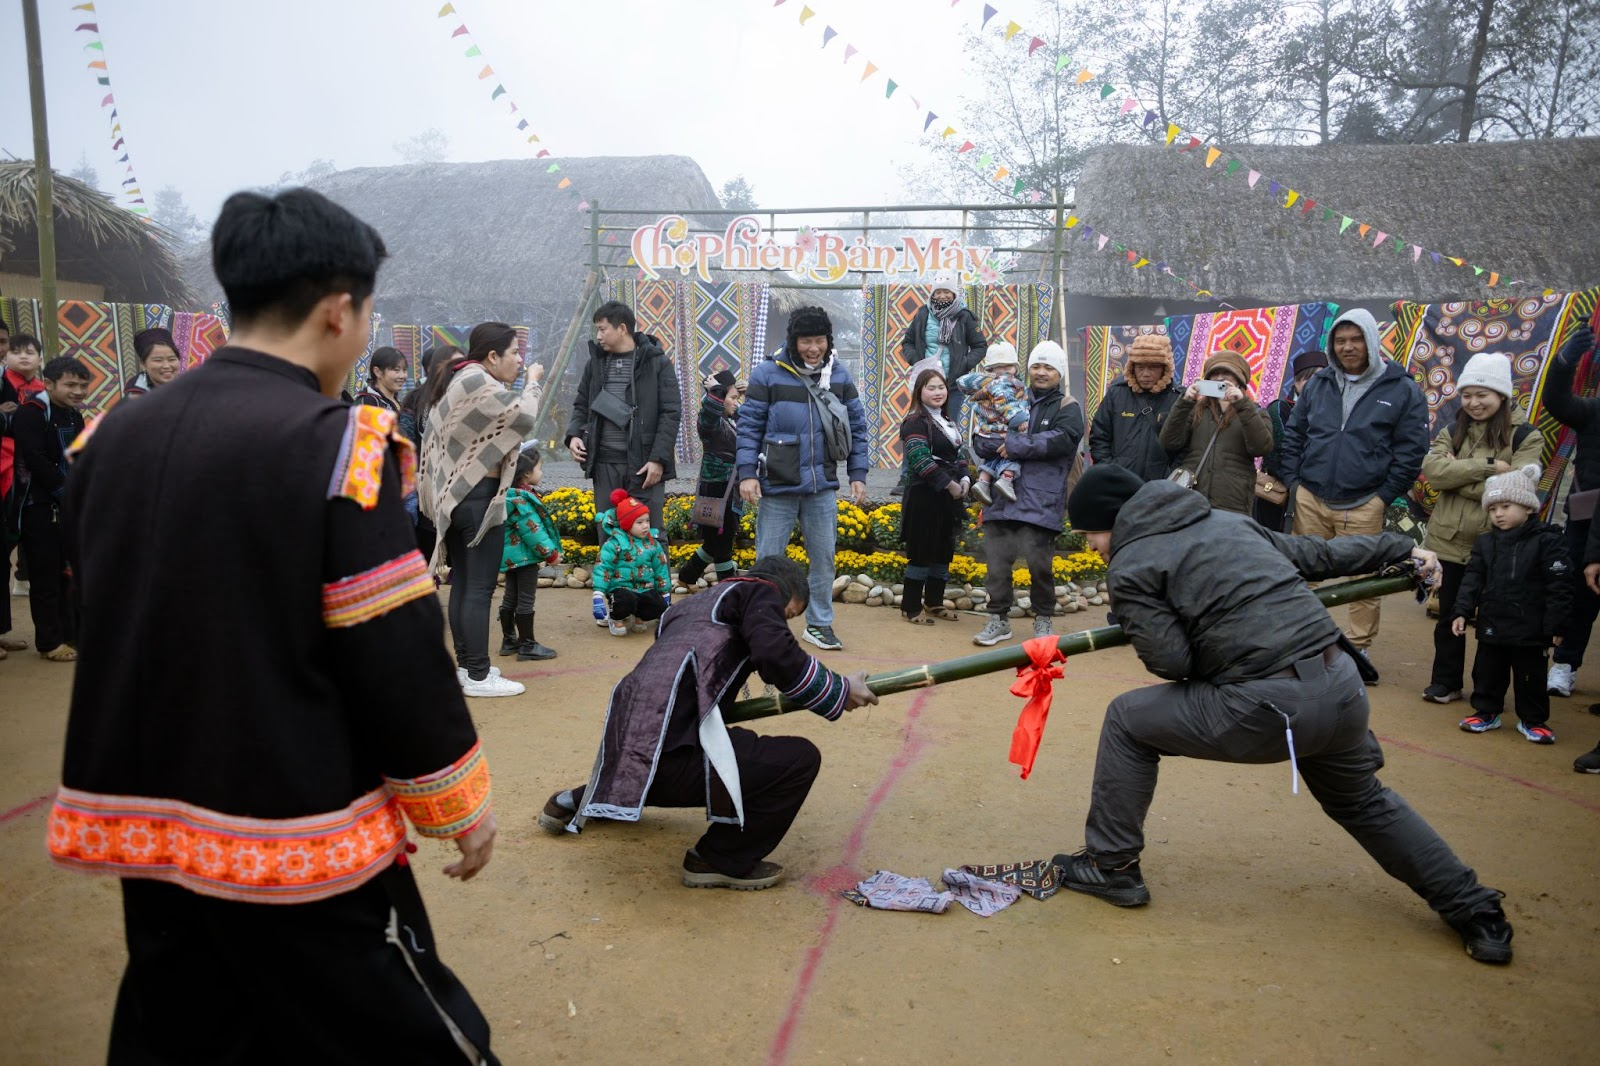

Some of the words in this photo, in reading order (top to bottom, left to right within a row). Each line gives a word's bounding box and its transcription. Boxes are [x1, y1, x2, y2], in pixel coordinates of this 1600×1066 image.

[632, 216, 696, 279] Chợ
[695, 217, 806, 282] Phiên
[808, 235, 896, 282] Bản
[902, 236, 992, 281] Mây
